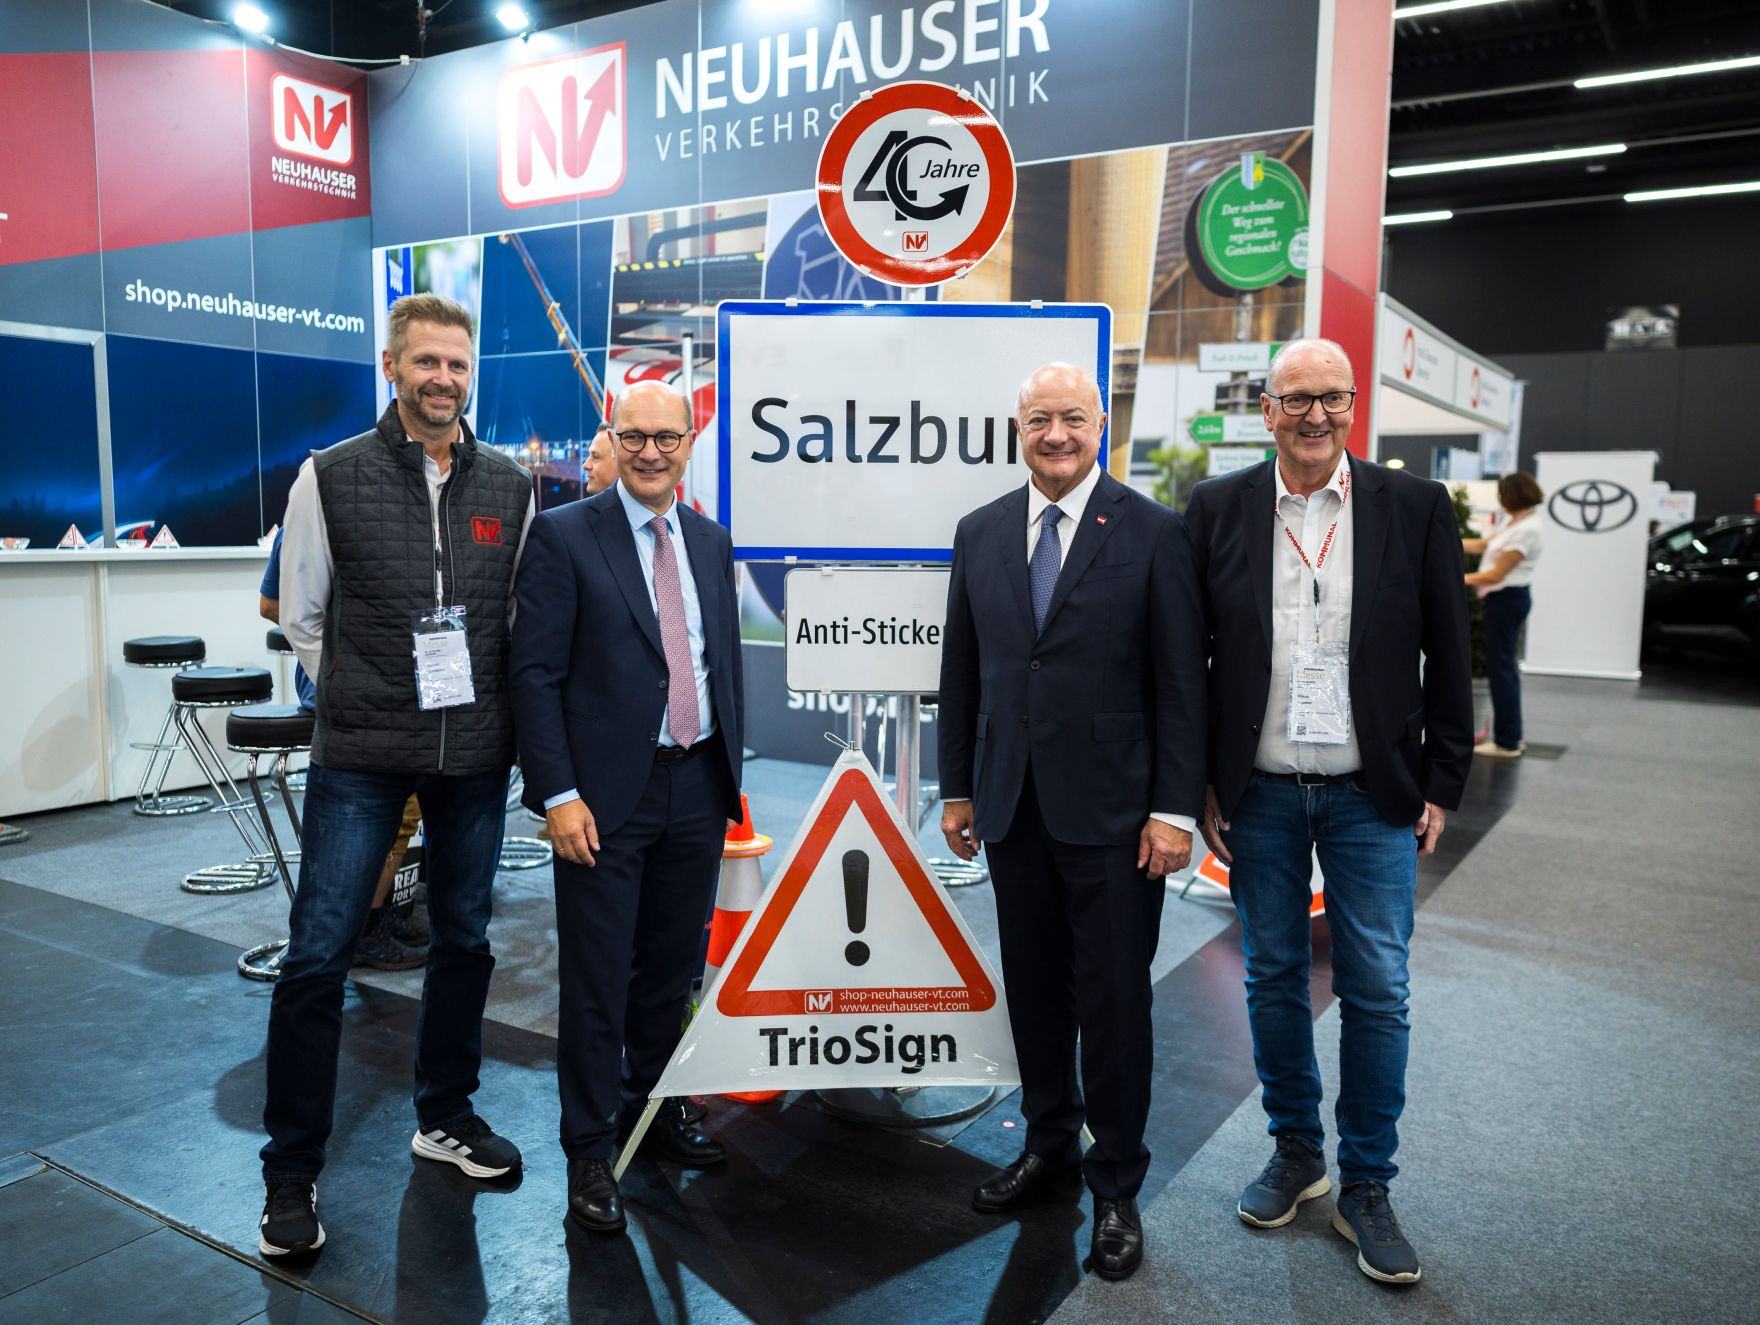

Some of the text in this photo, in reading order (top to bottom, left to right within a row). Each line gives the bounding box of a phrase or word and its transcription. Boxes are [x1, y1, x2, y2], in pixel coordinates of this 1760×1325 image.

[655, 0, 1050, 119] NEUHAUSER
[655, 69, 1049, 162] VERKEHRSNIK
[271, 155, 357, 190] NEUHAUSER
[272, 172, 357, 200] VERKEHRSTECHNIK
[919, 159, 980, 179] Jahre
[125, 279, 365, 334] shop.neuhauser-vt.com
[750, 397, 1018, 465] Salzbur
[1285, 526, 1312, 569] KOMMUNAL
[1316, 521, 1338, 569] KOMMUNAL
[796, 617, 942, 645] Anti-Sticke
[839, 989, 969, 1002] shop-neuhauser-vt.com
[839, 1000, 970, 1013] www.neuhauser-vt.com
[759, 1023, 957, 1074] TrioSign
